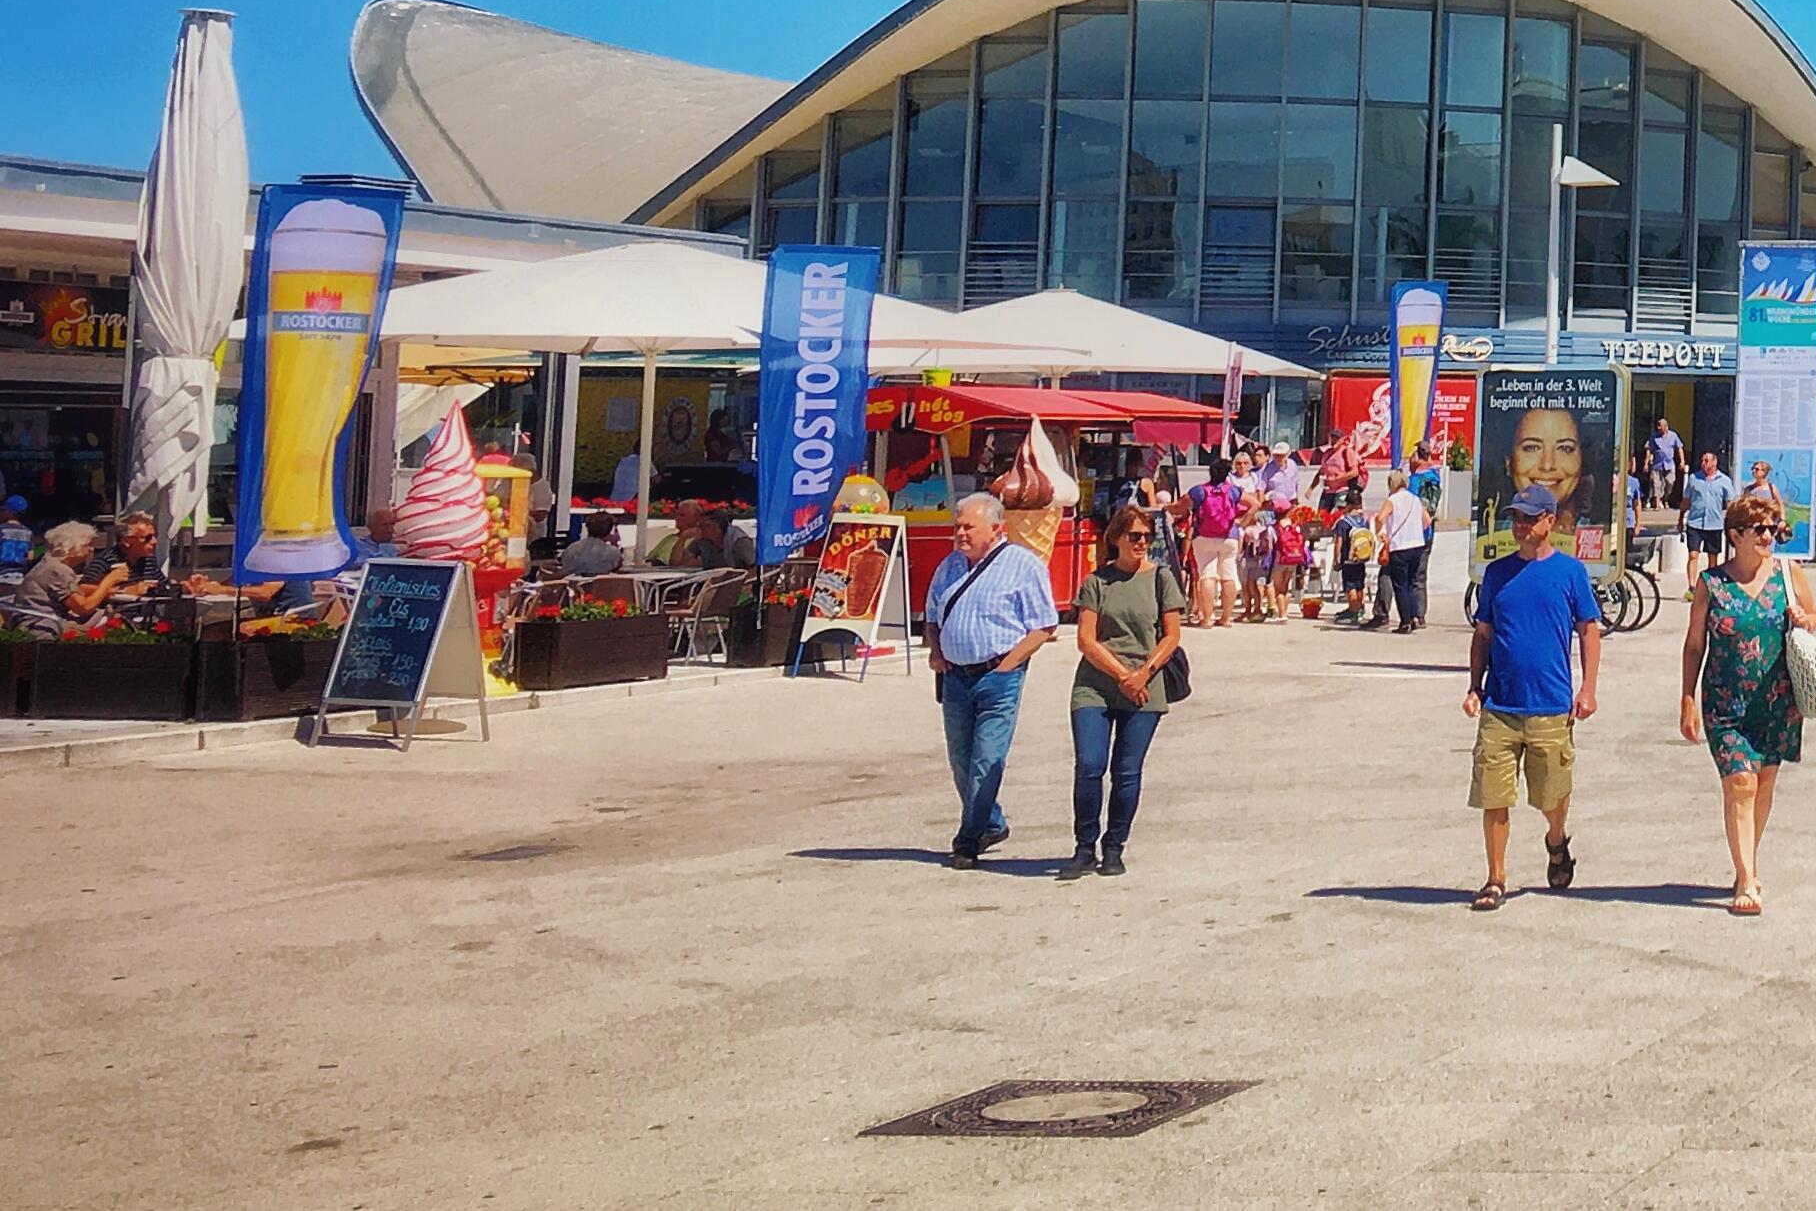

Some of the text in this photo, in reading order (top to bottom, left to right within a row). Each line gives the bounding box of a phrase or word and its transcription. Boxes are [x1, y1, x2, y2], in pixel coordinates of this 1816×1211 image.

[281, 314, 362, 329] ROSTOCKER
[1602, 341, 1725, 368] TEEPOTT
[791, 261, 850, 496] ROSTOCKER
[1496, 379, 1602, 392] „Leben in der 3. Welt
[1490, 395, 1528, 411] beginnt
[1530, 395, 1545, 408] oft
[1548, 396, 1565, 408] mit
[1567, 395, 1576, 408] 1.
[931, 410, 965, 424] dog
[828, 526, 892, 556] DÖNER
